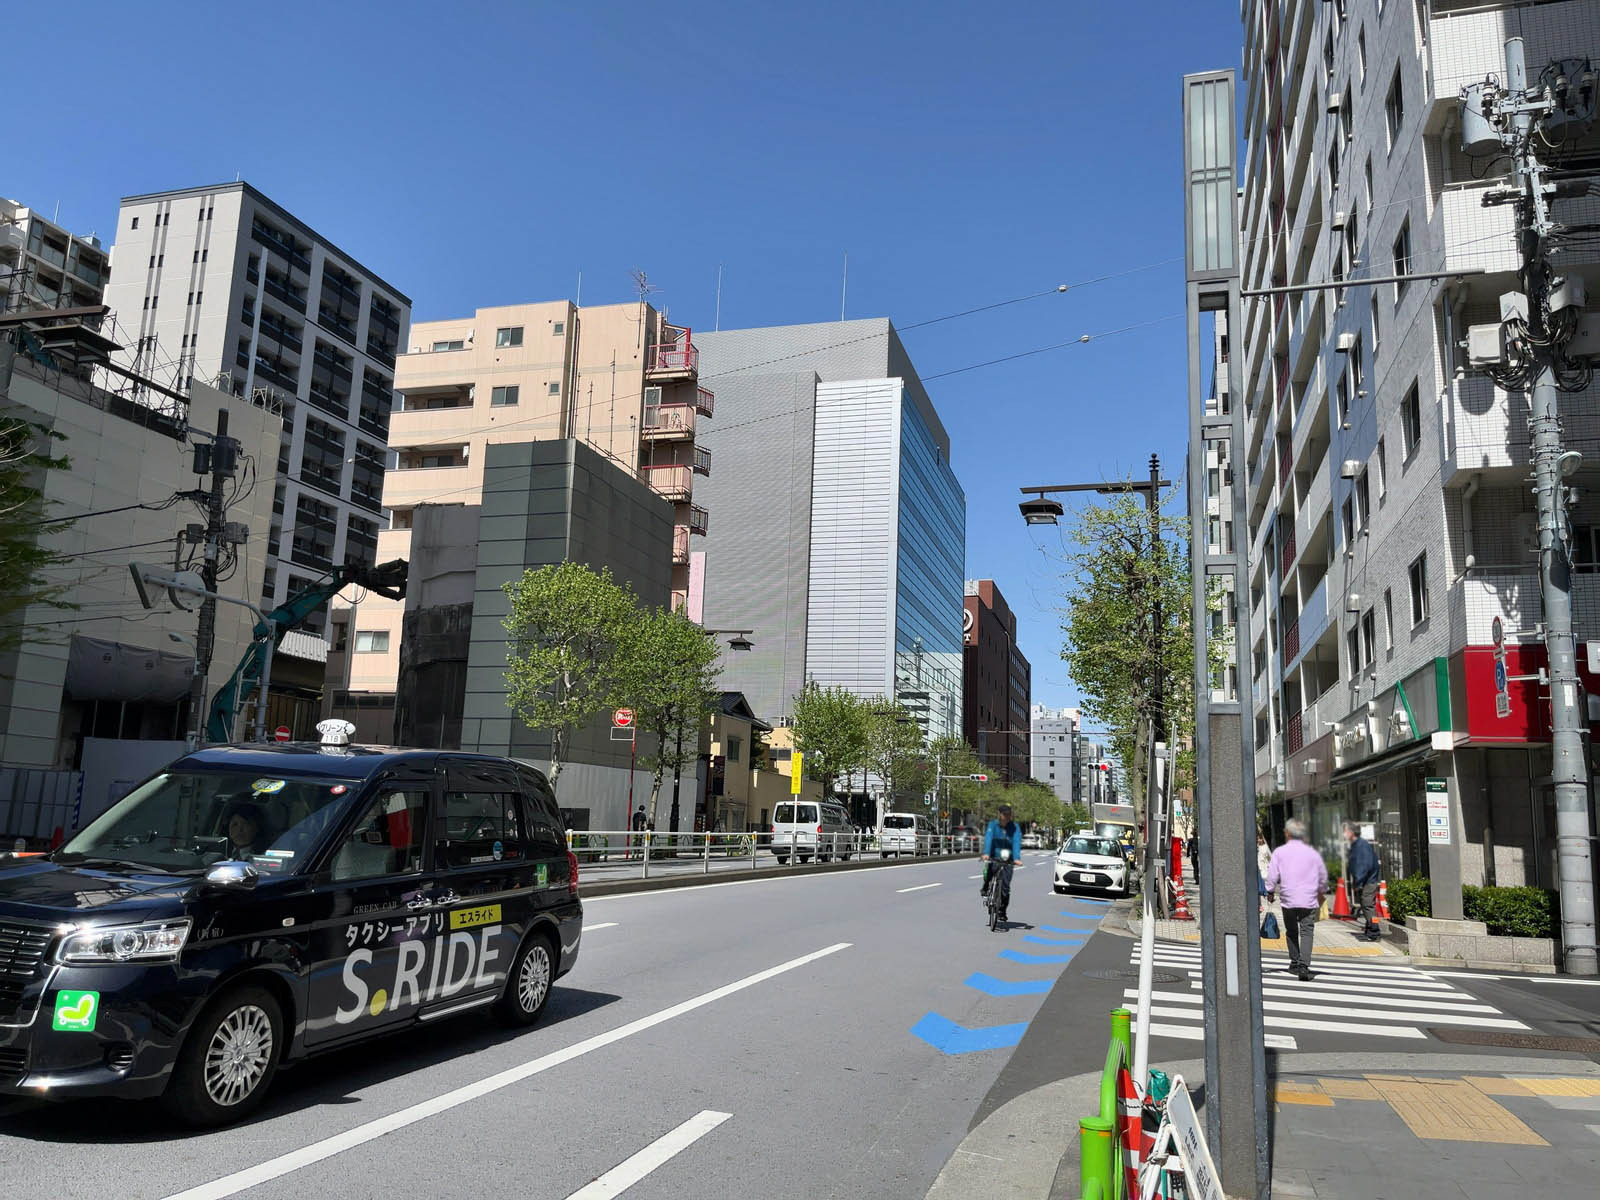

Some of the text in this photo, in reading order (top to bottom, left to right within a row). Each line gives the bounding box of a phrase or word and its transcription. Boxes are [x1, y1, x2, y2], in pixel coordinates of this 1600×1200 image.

[345, 912, 444, 947] タクシーアプリ
[459, 908, 494, 925] エスライド
